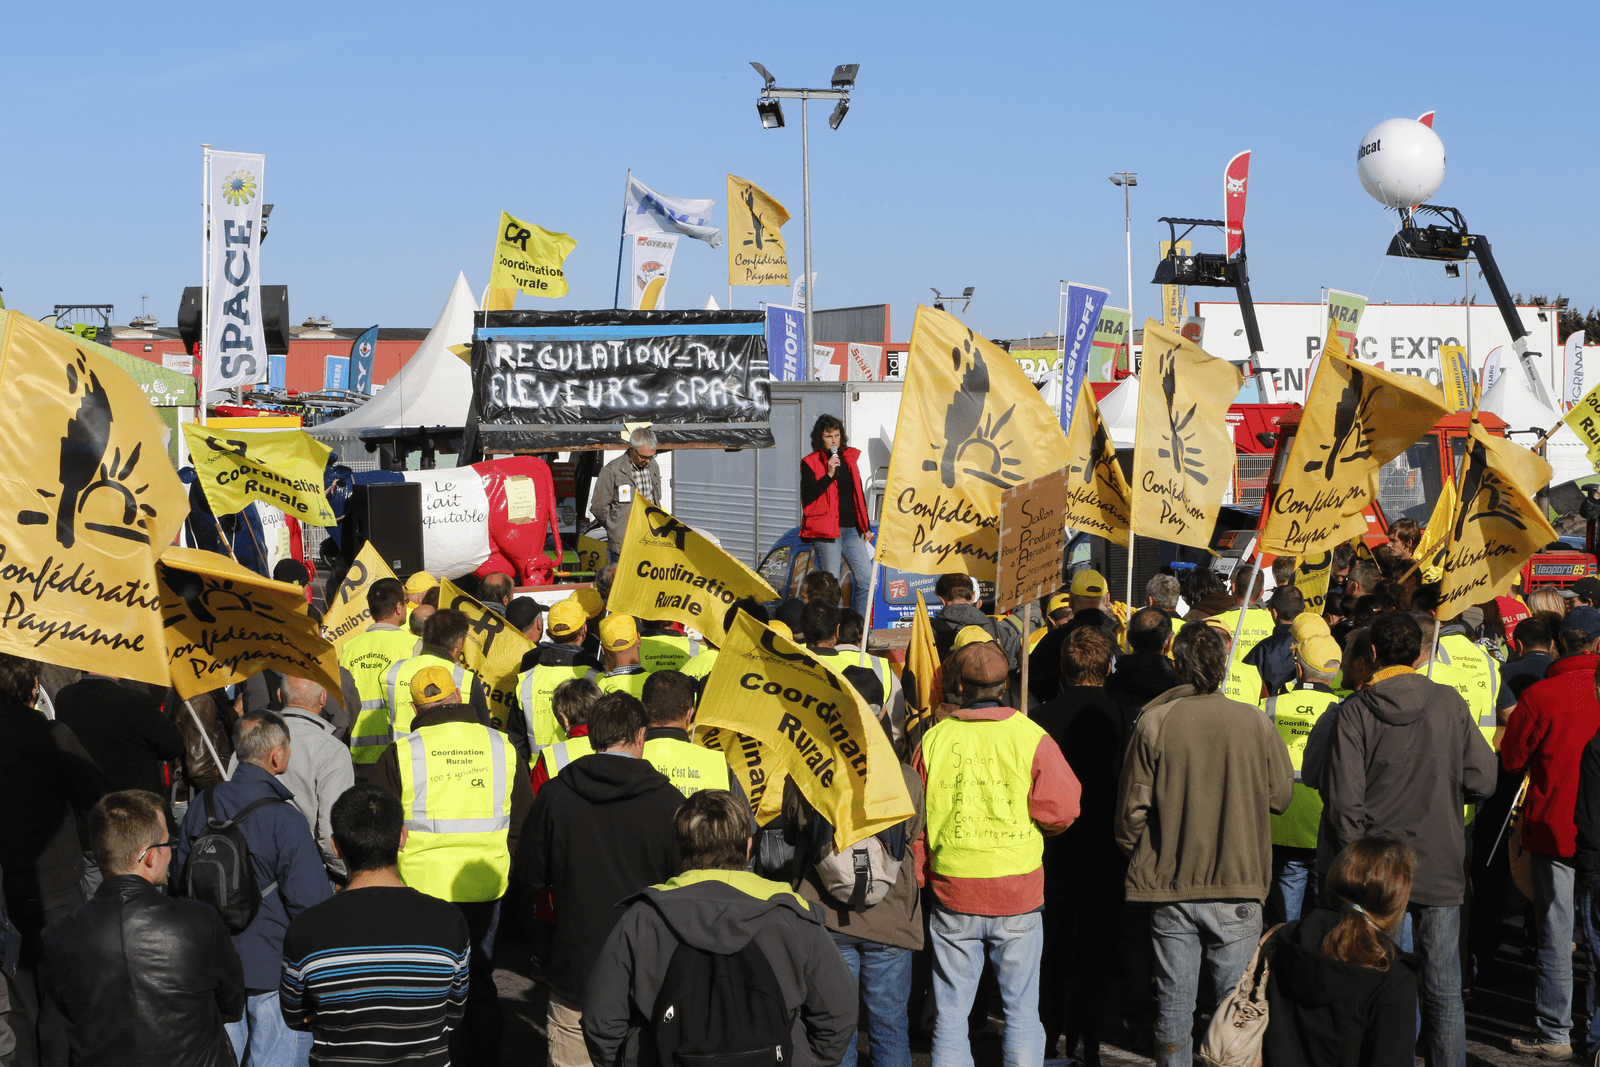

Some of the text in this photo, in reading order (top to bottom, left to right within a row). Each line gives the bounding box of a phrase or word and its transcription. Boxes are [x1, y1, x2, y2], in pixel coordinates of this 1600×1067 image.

[504, 222, 532, 252] CR
[646, 240, 675, 249] GYRAX
[220, 219, 257, 380] SPACE
[150, 392, 179, 407] e.fr
[244, 480, 309, 513] Rurale
[434, 481, 457, 493] Le
[422, 509, 487, 529] quitable
[1020, 499, 1054, 529] Salon
[1066, 486, 1130, 527] nfédération
[0, 545, 160, 611] onfédératio
[909, 577, 935, 587] Intérieur
[917, 585, 936, 594] xtérie
[654, 591, 703, 616] Rurale
[890, 588, 906, 598] 7€
[2, 591, 144, 653] Paysanne
[189, 650, 310, 679] Paysanne
[1296, 705, 1315, 715] CR
[431, 749, 485, 757] Coordination
[777, 711, 835, 788] Rurale
[951, 742, 995, 768] Salon
[470, 778, 486, 788] CR
